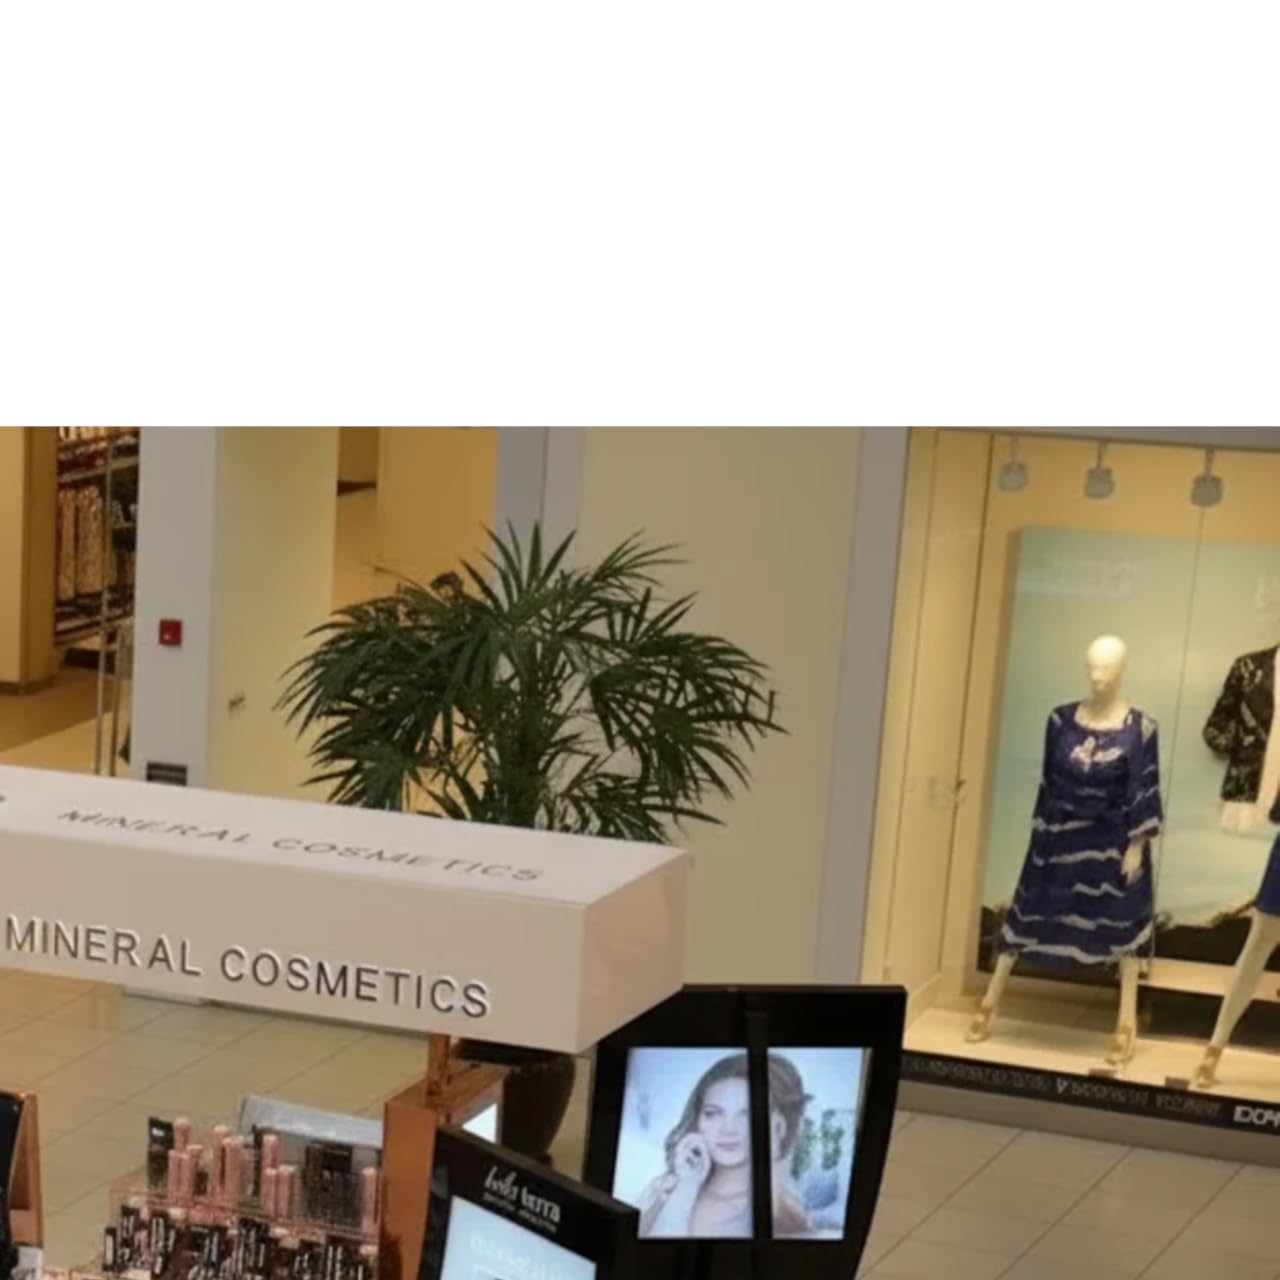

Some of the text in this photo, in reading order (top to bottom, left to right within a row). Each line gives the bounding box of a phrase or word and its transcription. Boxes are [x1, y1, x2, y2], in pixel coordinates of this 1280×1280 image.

[57, 808, 545, 882] MINERAL COSMETICS
[4, 912, 491, 1020] MINERAL COSMETICS
